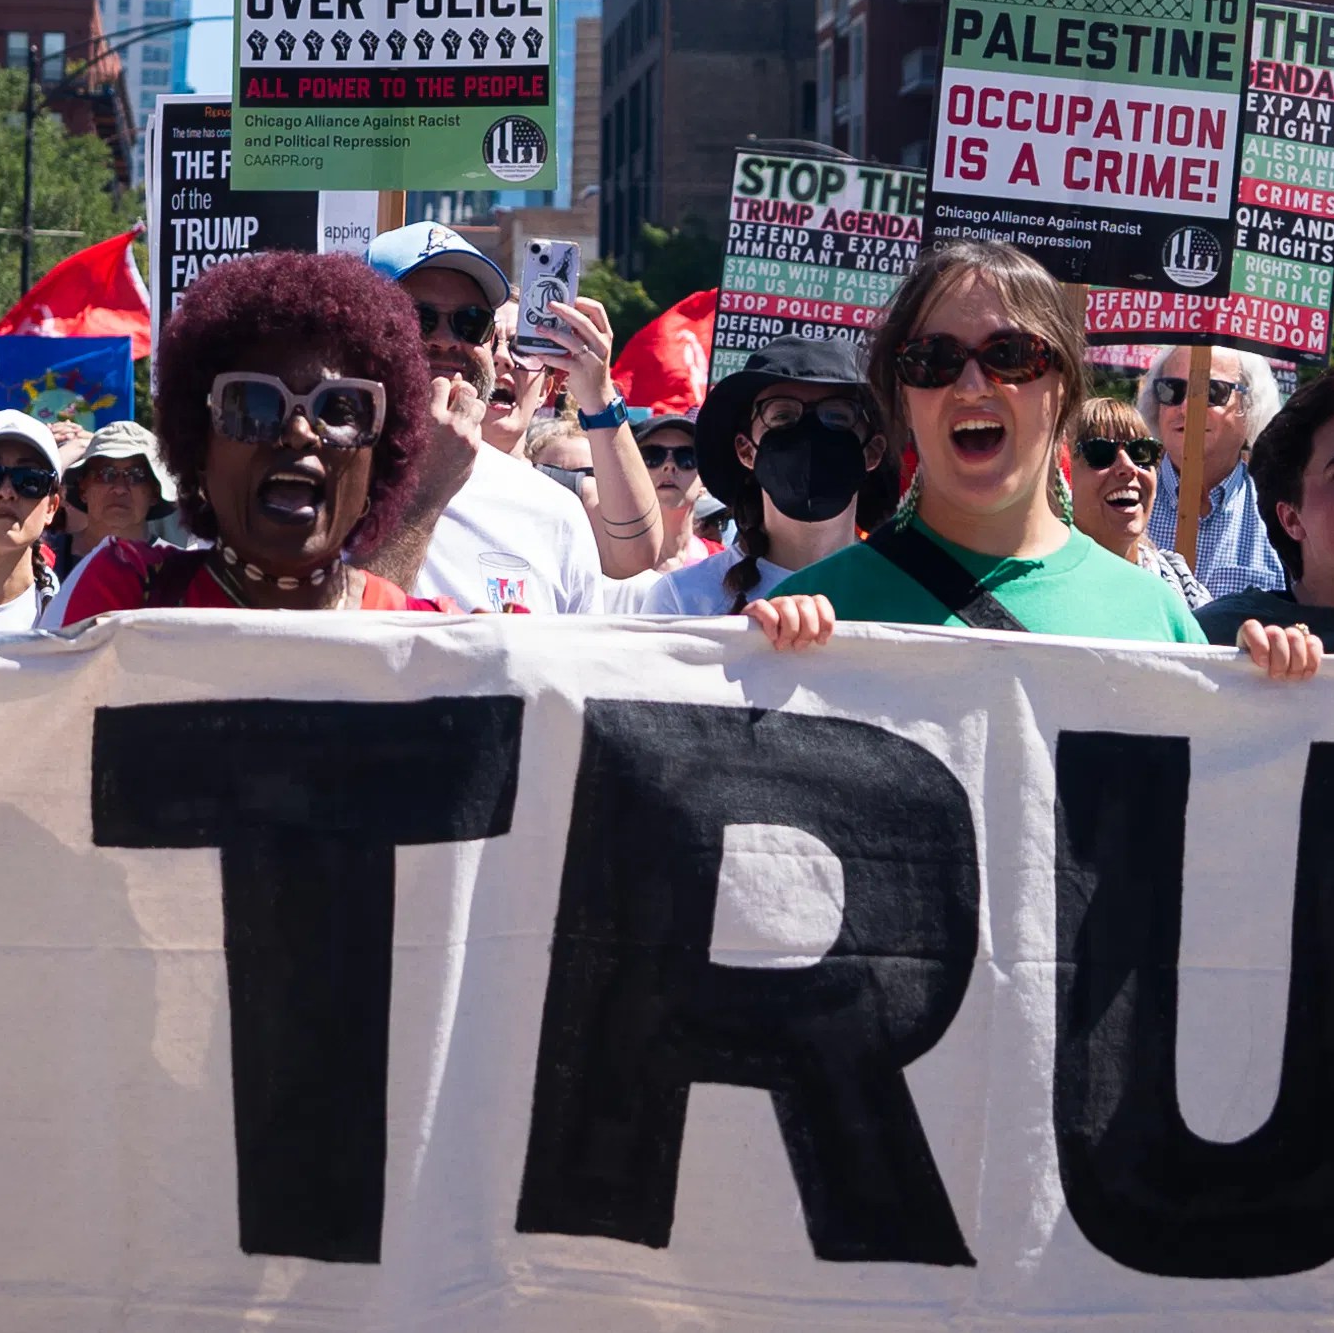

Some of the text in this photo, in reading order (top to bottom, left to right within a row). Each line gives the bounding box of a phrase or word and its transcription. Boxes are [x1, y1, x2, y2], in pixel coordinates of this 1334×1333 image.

[950, 9, 1235, 81] PALESTINE
[246, 75, 544, 99] ALL POWER TO THE PEOPLE
[244, 113, 461, 131] Chicago Alliance Against Racist
[946, 84, 1227, 150] OCCUPATION
[172, 127, 216, 138] The time has
[244, 134, 411, 151] and Political Repression
[172, 150, 215, 180] THE
[243, 154, 324, 170] CAARPR.org
[944, 135, 1219, 203] IS A CRIME!
[736, 156, 847, 204] STOP
[171, 187, 211, 211] of the
[732, 197, 814, 226] TRUMP
[935, 205, 1142, 236] Chicago Alliance Against Racist
[1236, 207, 1285, 231] QIA+
[171, 217, 259, 251] TRUMP
[729, 222, 810, 246] DEFEND
[822, 233, 835, 250] &
[848, 237, 917, 259] EXPAN
[934, 224, 1092, 251] and Political Repression
[1258, 233, 1334, 263] RIGHTS
[727, 240, 844, 267] IMMIGRANT
[725, 259, 830, 283] STAND WITH
[1245, 256, 1332, 285] RIGHTS TO
[724, 274, 855, 302] END US AID TO
[1245, 274, 1330, 307] STRIKE
[720, 293, 768, 310] STOP
[777, 299, 844, 321] POLICE
[1085, 291, 1325, 330] DEFEND EDUCATION &
[717, 314, 784, 335] DEFEND
[1216, 315, 1324, 350] FREEDOM
